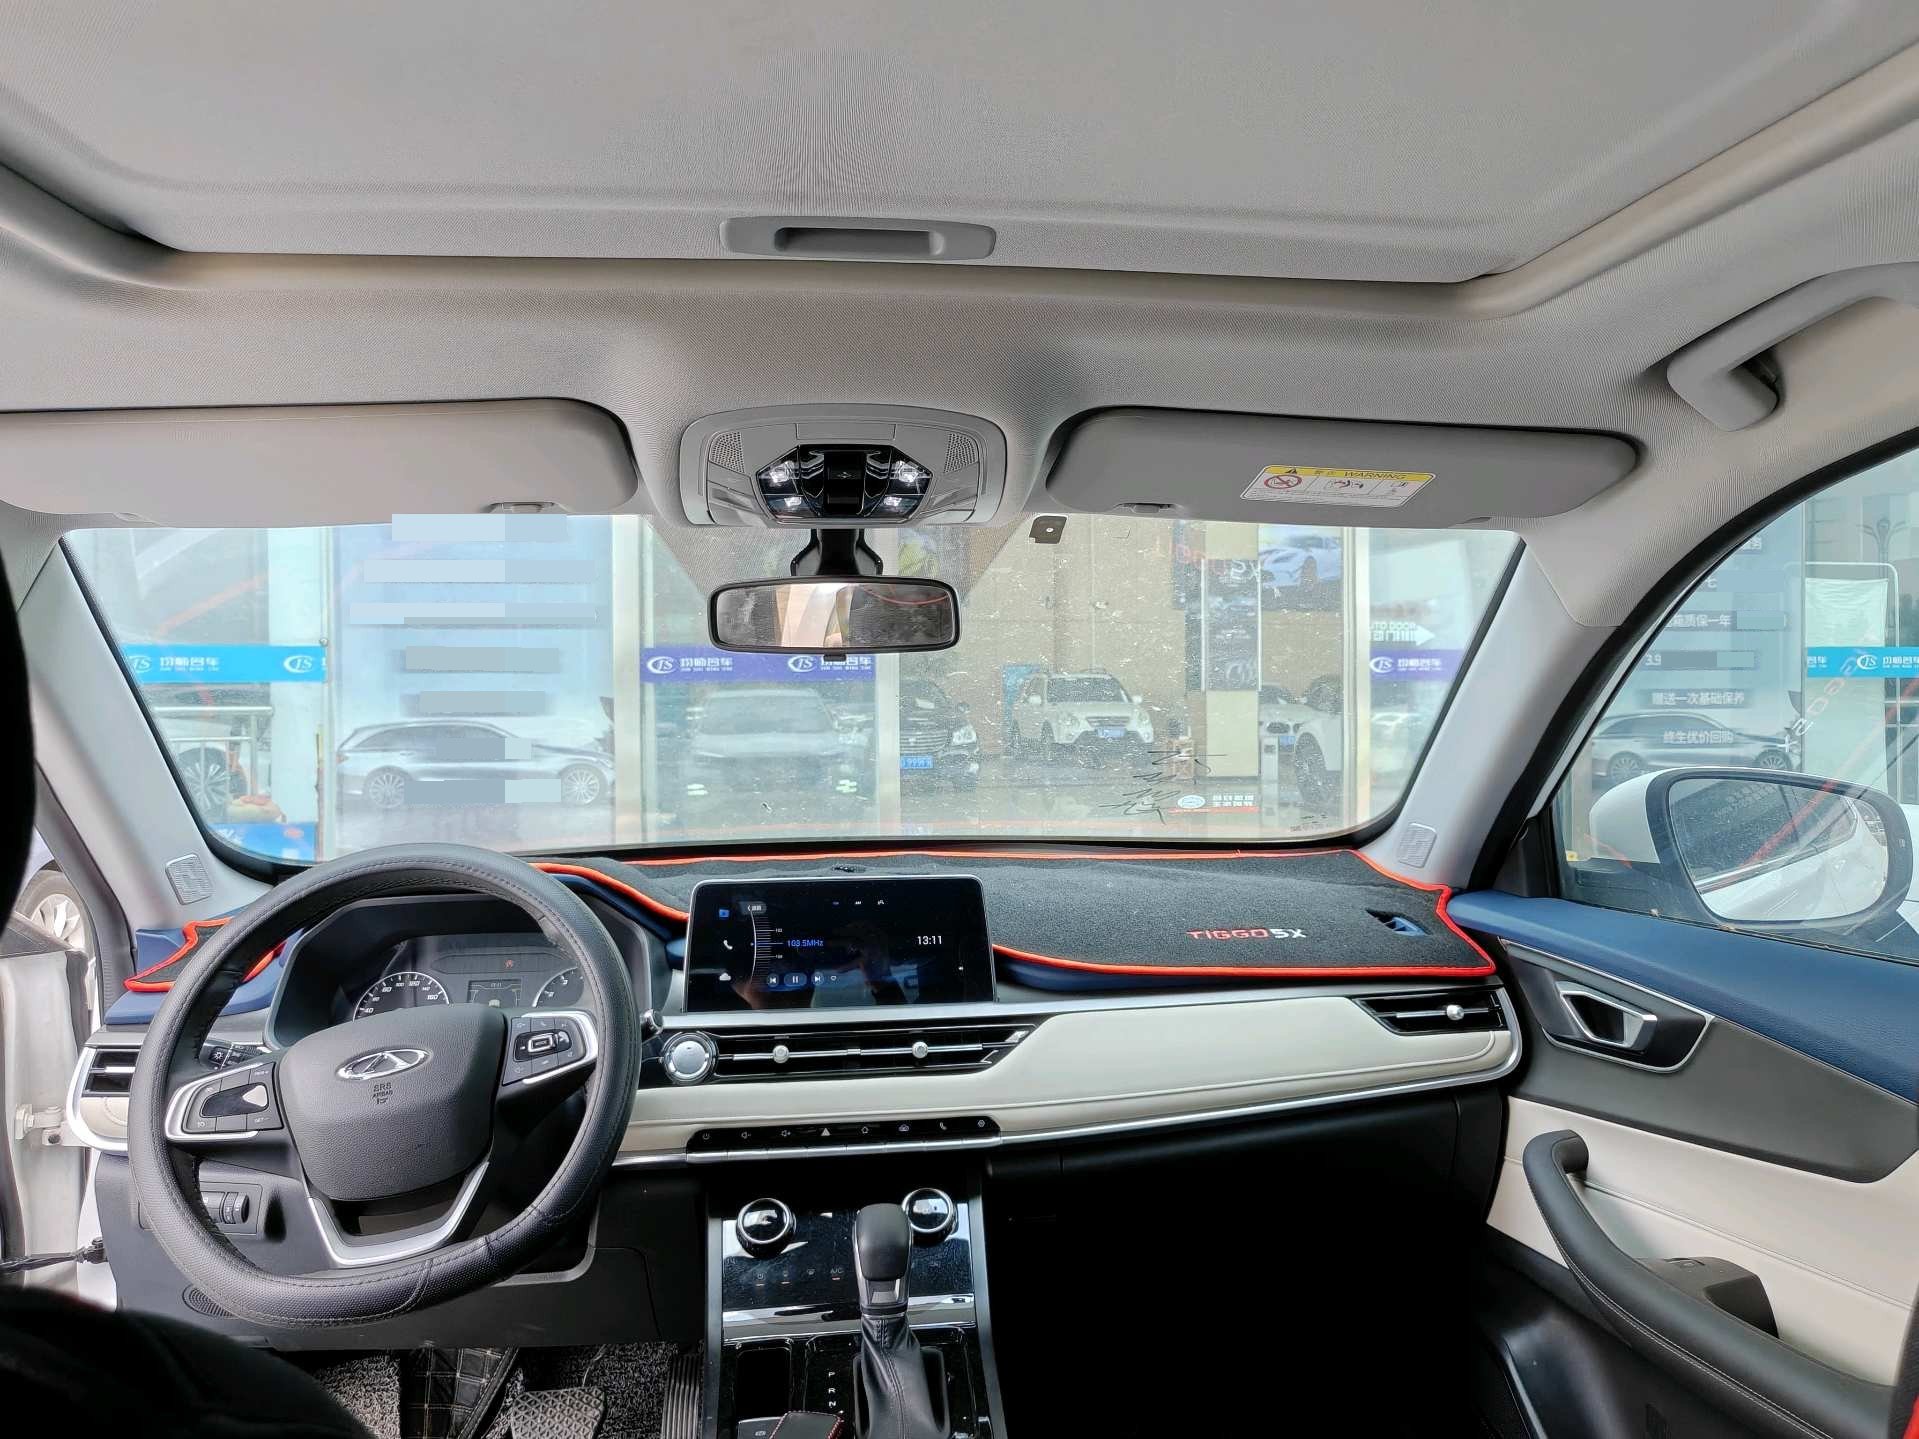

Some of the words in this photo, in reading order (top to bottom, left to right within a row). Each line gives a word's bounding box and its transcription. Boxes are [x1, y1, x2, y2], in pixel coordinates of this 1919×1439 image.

[1344, 471, 1407, 480] WARNING
[1187, 928, 1306, 940] TIGGO5X
[787, 939, 824, 948] 103.5MHz
[917, 935, 942, 945] 13:11
[373, 1082, 392, 1091] SRS
